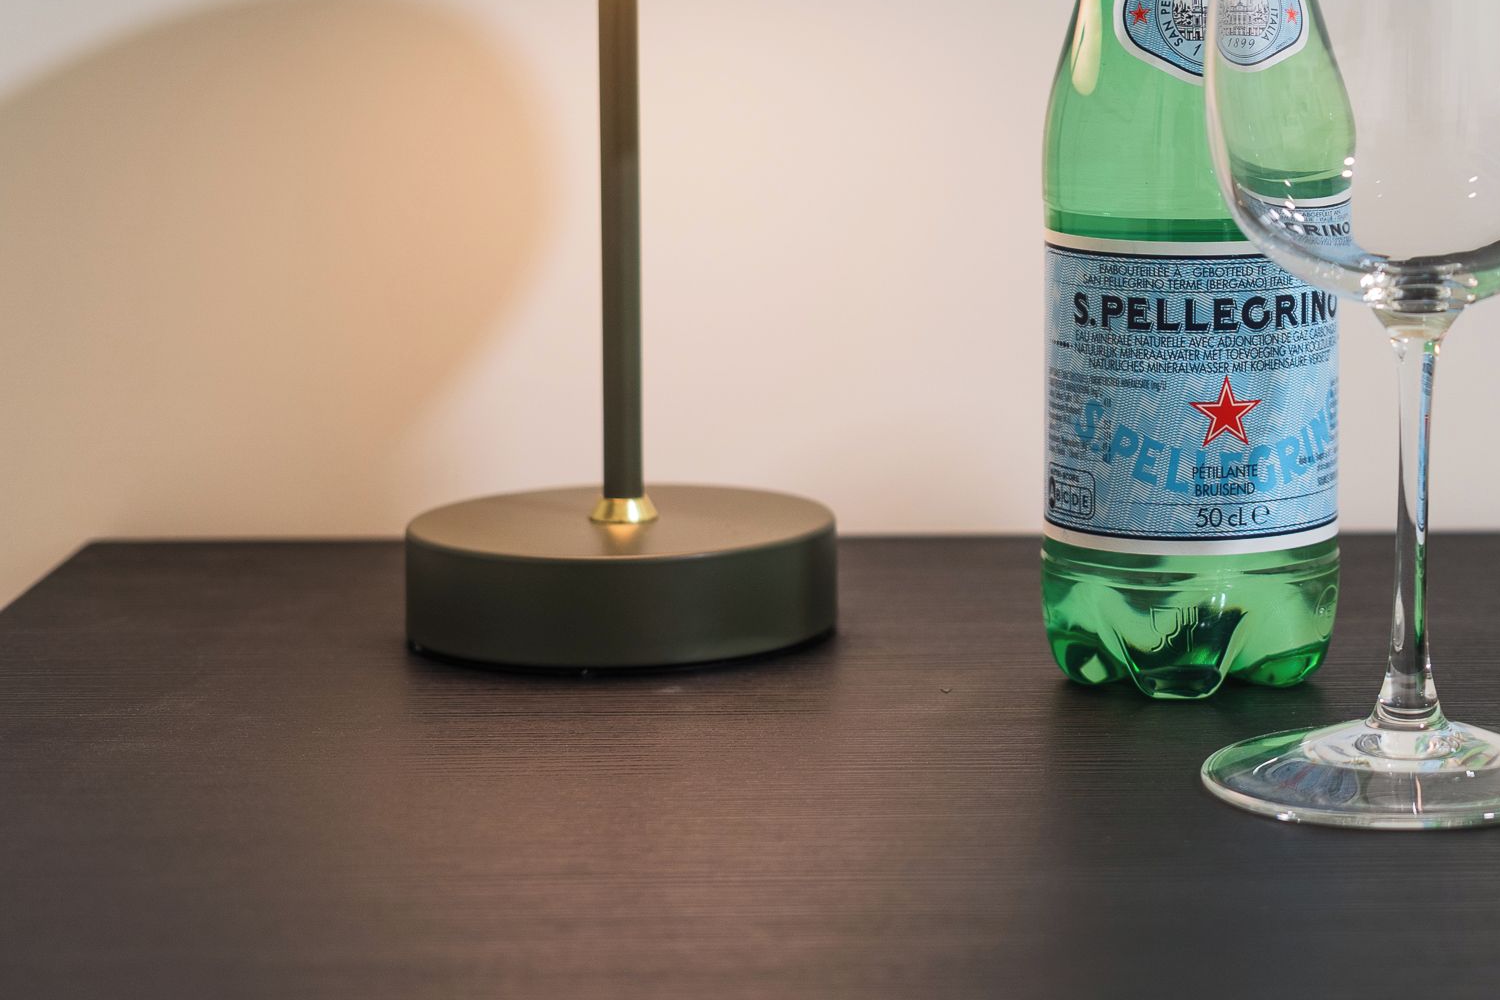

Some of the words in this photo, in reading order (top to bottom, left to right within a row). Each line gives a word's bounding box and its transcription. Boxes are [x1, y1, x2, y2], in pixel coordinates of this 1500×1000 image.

[1261, 8, 1279, 41] ITALIA
[1162, 20, 1184, 47] SAN
[1227, 37, 1256, 50] 1899
[1193, 265, 1254, 278] GEBOTTELD
[1256, 265, 1267, 276] TE
[1082, 272, 1101, 285] SAN
[1103, 276, 1165, 290] PELLEGRINO
[1169, 279, 1201, 291] TERME
[1206, 278, 1267, 291] (BERGAMO)
[1268, 275, 1294, 287] ITALIE
[1073, 290, 1338, 333] S.PELLEGRINO
[1134, 335, 1185, 349] NATURELLE
[1189, 336, 1215, 349] AVEC
[1217, 332, 1280, 349] ADJONCTION
[1281, 331, 1292, 344] DE
[1119, 347, 1200, 361] MINERAALWATER
[1203, 348, 1222, 361] MET
[1225, 345, 1287, 361] TOEVOEGING
[1146, 361, 1230, 374] MINERALWASSER
[1231, 362, 1248, 373] MIT
[1192, 463, 1258, 479] PÉTILLANTE
[1195, 482, 1256, 497] BRUISEND
[1195, 507, 1223, 528] 50
